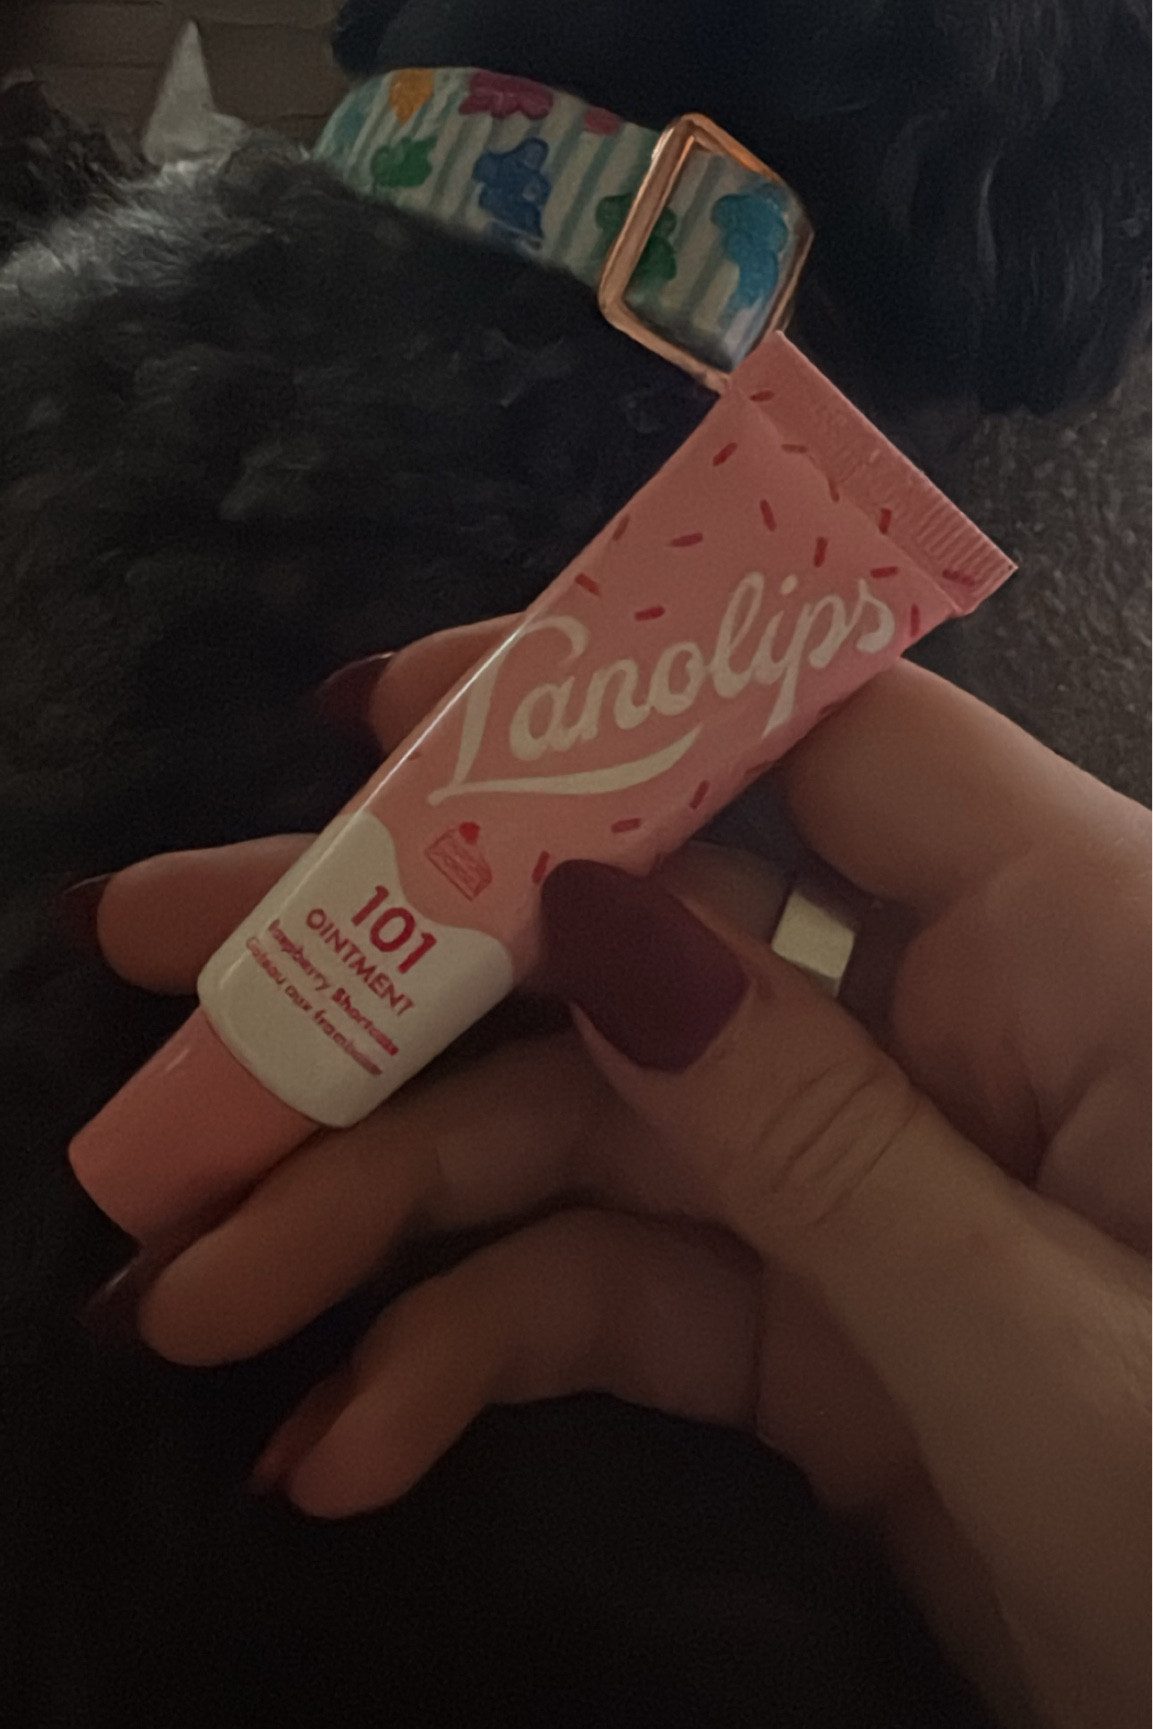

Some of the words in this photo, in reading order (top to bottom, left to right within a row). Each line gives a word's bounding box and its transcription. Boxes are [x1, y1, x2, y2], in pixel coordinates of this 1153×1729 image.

[427, 571, 896, 807] Lanolips
[306, 908, 415, 1016] OINTMENT
[351, 885, 437, 975] 101
